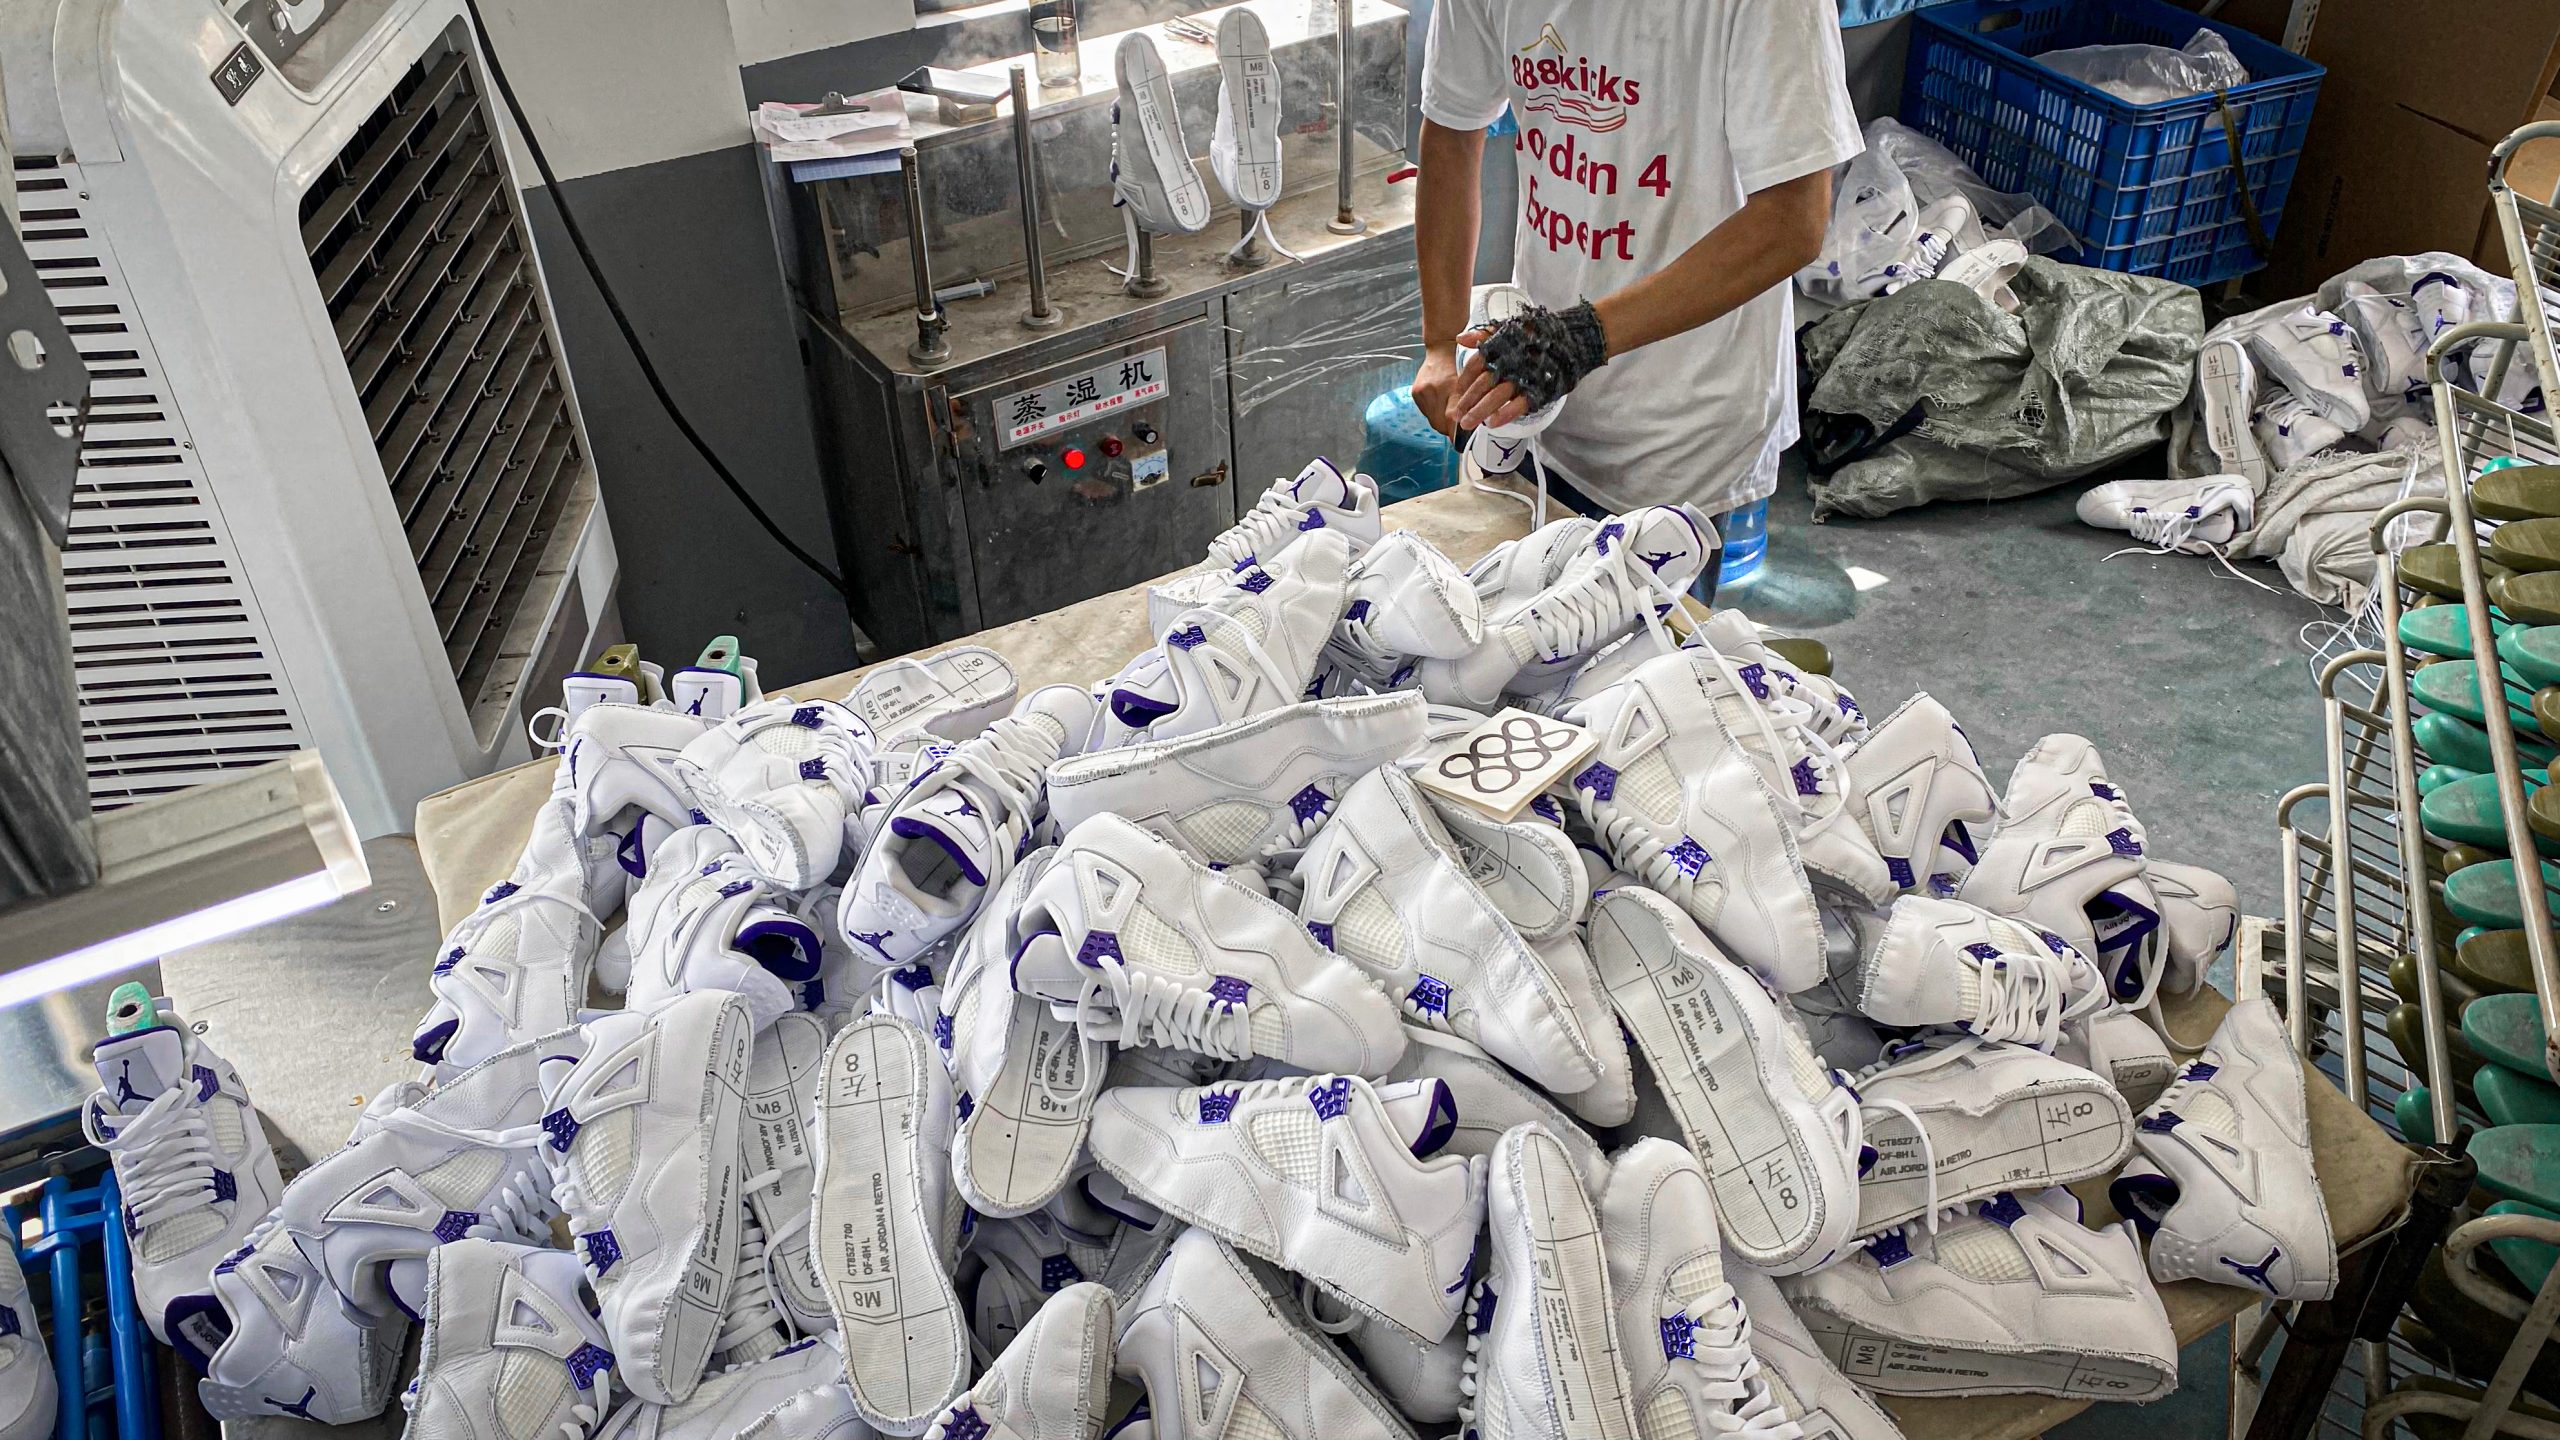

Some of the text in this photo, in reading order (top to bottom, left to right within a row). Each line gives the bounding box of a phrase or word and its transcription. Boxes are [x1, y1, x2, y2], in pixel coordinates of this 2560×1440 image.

[1250, 62, 1263, 72] M8
[1263, 179, 1270, 190] 8
[1638, 154, 1672, 198] 4
[1181, 205, 1188, 216] 8
[1526, 174, 1636, 261] Expert
[1012, 360, 1153, 425] 蒸湿机
[971, 658, 984, 667] 8
[866, 700, 880, 720] M8
[1671, 966, 1695, 988] M8
[737, 1038, 744, 1058] 8
[1672, 1003, 1685, 1019] AIR
[1679, 1020, 1700, 1056] JORDAN
[1698, 1060, 1719, 1092] RETRO
[845, 1054, 859, 1073] 8
[2134, 1070, 2151, 1078] 8
[841, 1073, 867, 1097] 左
[756, 1101, 781, 1116] M8
[2047, 1103, 2072, 1129] 左
[2073, 1102, 2093, 1117] 8
[758, 1123, 767, 1136] AIR
[1878, 1136, 1913, 1148] CT8527
[1880, 1166, 1898, 1176] AIR
[1898, 1161, 1938, 1175] JORDA
[1946, 1149, 1972, 1166] RETRO
[721, 1165, 731, 1198] RETRO
[1761, 1159, 1792, 1189] 左
[1780, 1187, 1798, 1209] 8
[872, 1172, 890, 1273] AIR JORDAN 4 RETRO
[843, 1223, 857, 1277] CT8527 700
[693, 1274, 712, 1295] M8
[853, 1290, 881, 1309] M8
[1856, 1345, 1877, 1365] M8
[1906, 1365, 1946, 1374] JORDAN
[1955, 1368, 1989, 1378] RETRO
[2108, 1380, 2129, 1389] 8
[1561, 1379, 1575, 1421] RETRO
